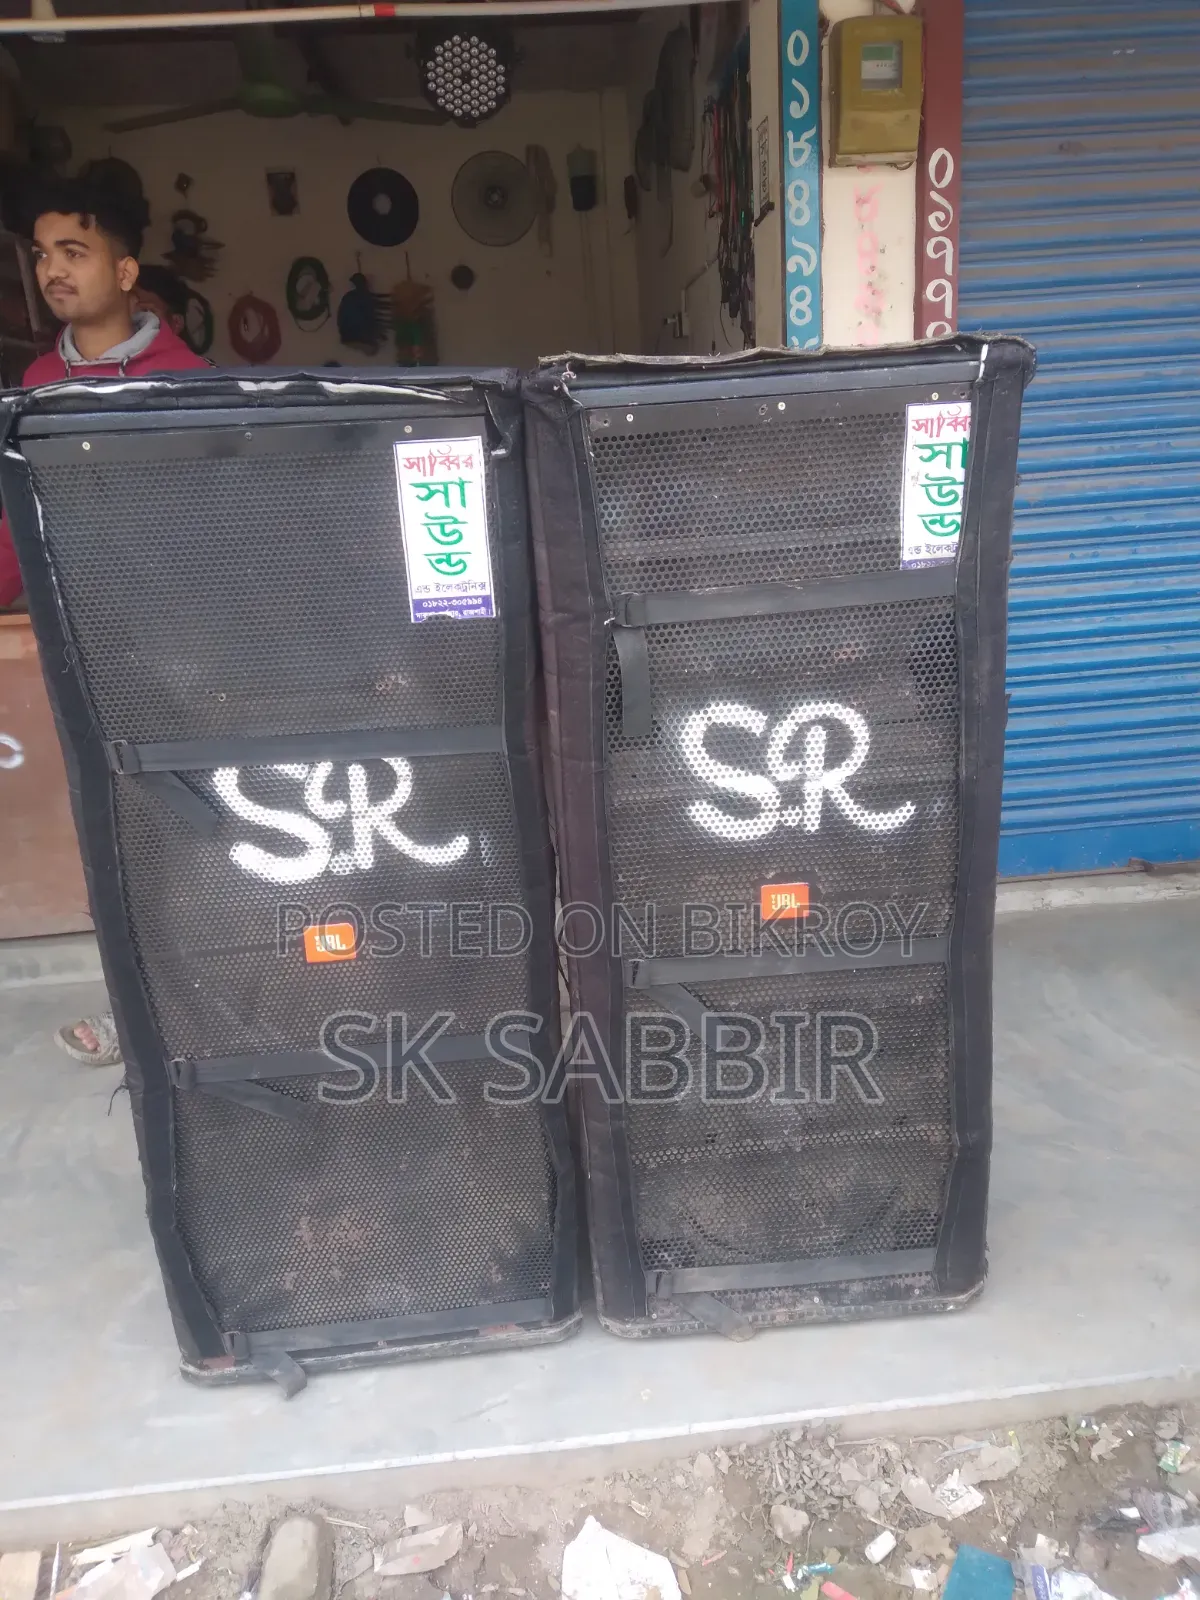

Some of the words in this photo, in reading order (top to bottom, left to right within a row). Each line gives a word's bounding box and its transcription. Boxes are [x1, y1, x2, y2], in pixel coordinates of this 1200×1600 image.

[912, 405, 971, 438] সাব্বি
[770, 892, 801, 911] JBL
[314, 934, 347, 953] JBL
